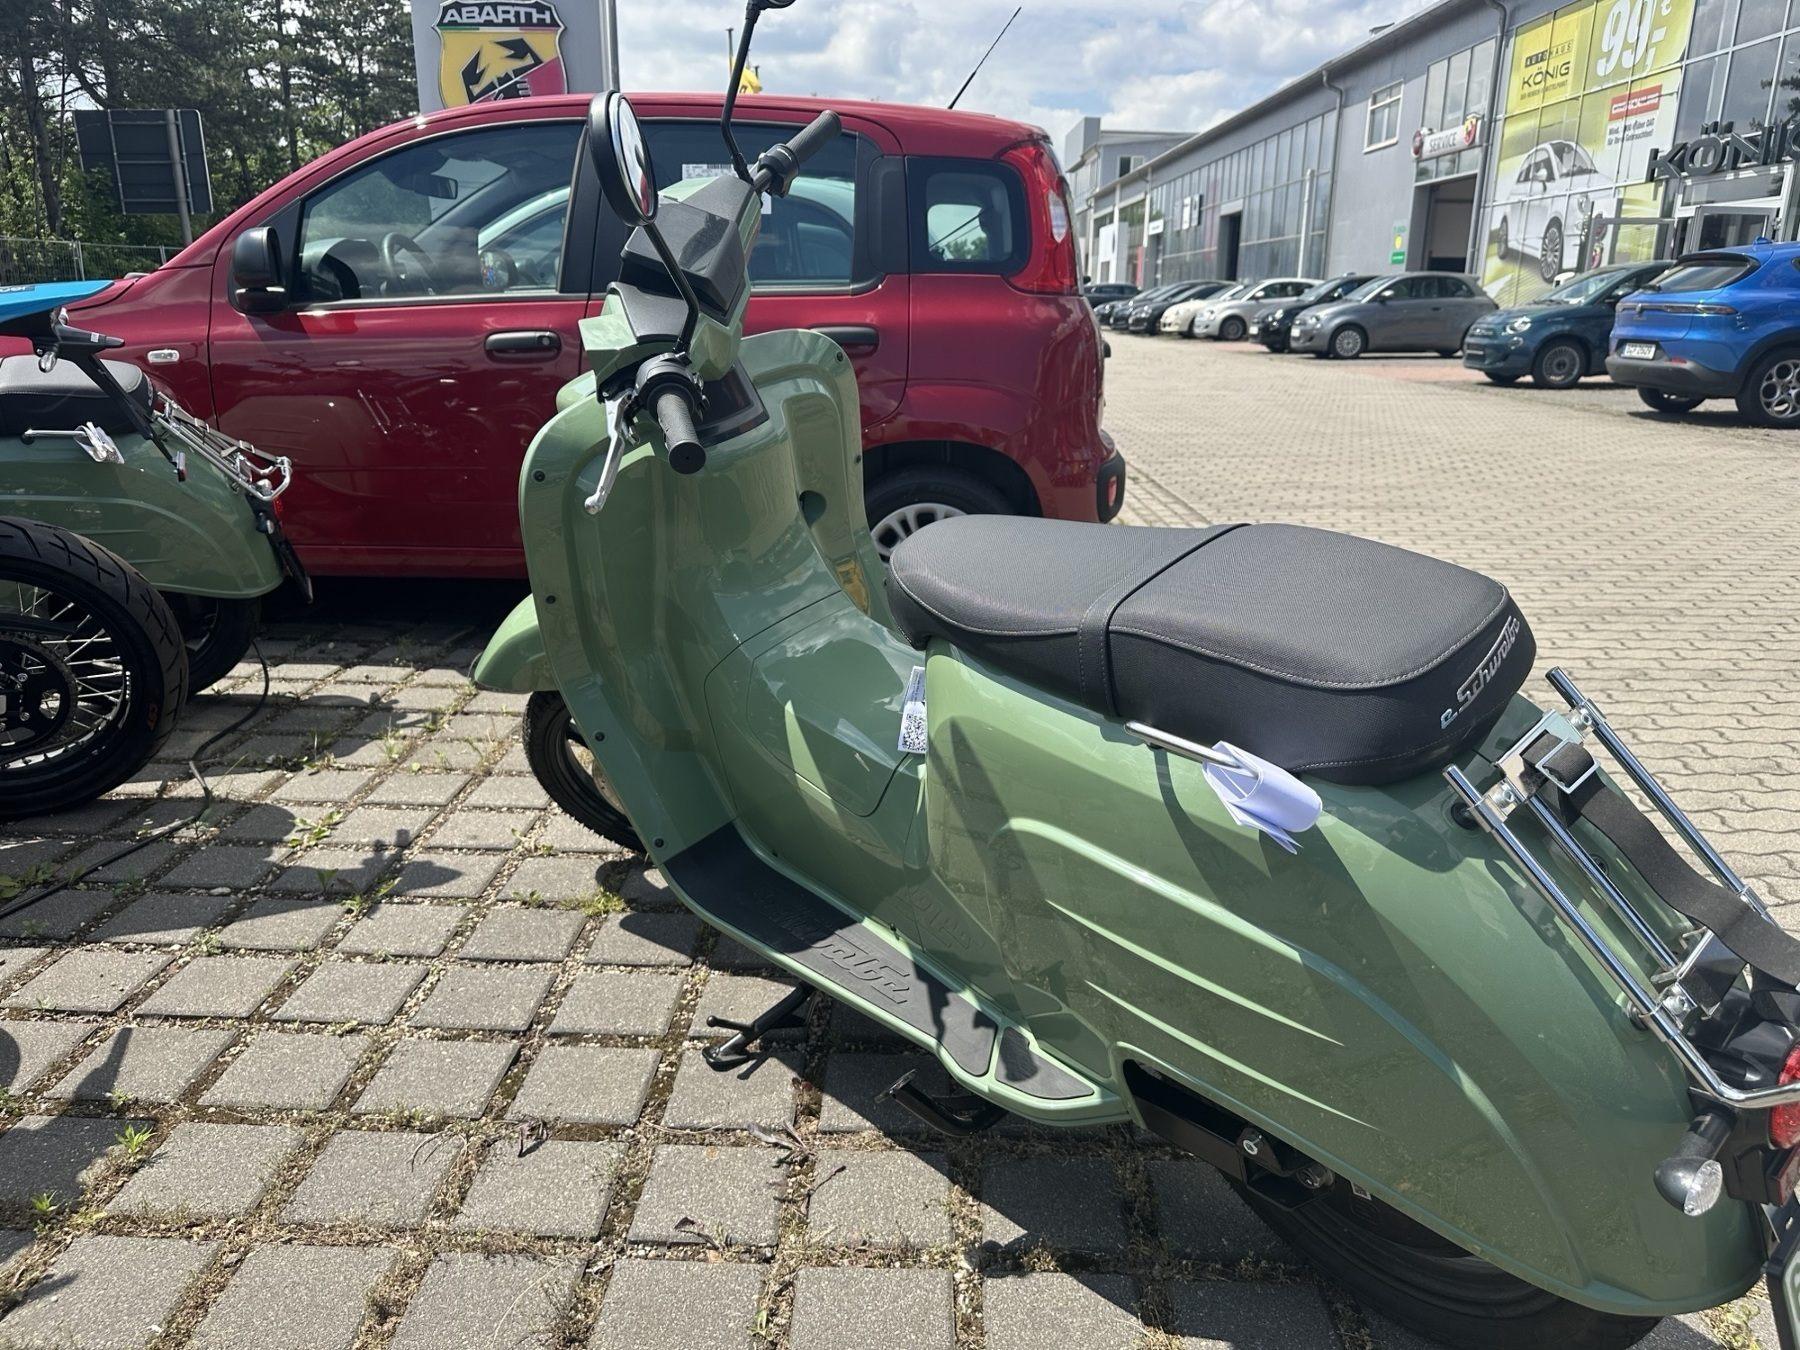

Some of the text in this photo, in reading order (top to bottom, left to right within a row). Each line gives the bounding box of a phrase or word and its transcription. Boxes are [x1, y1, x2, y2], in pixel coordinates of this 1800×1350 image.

[442, 6, 551, 24] ABARTH
[1521, 60, 1571, 91] KÖNIG
[1429, 131, 1457, 153] SERVICE
